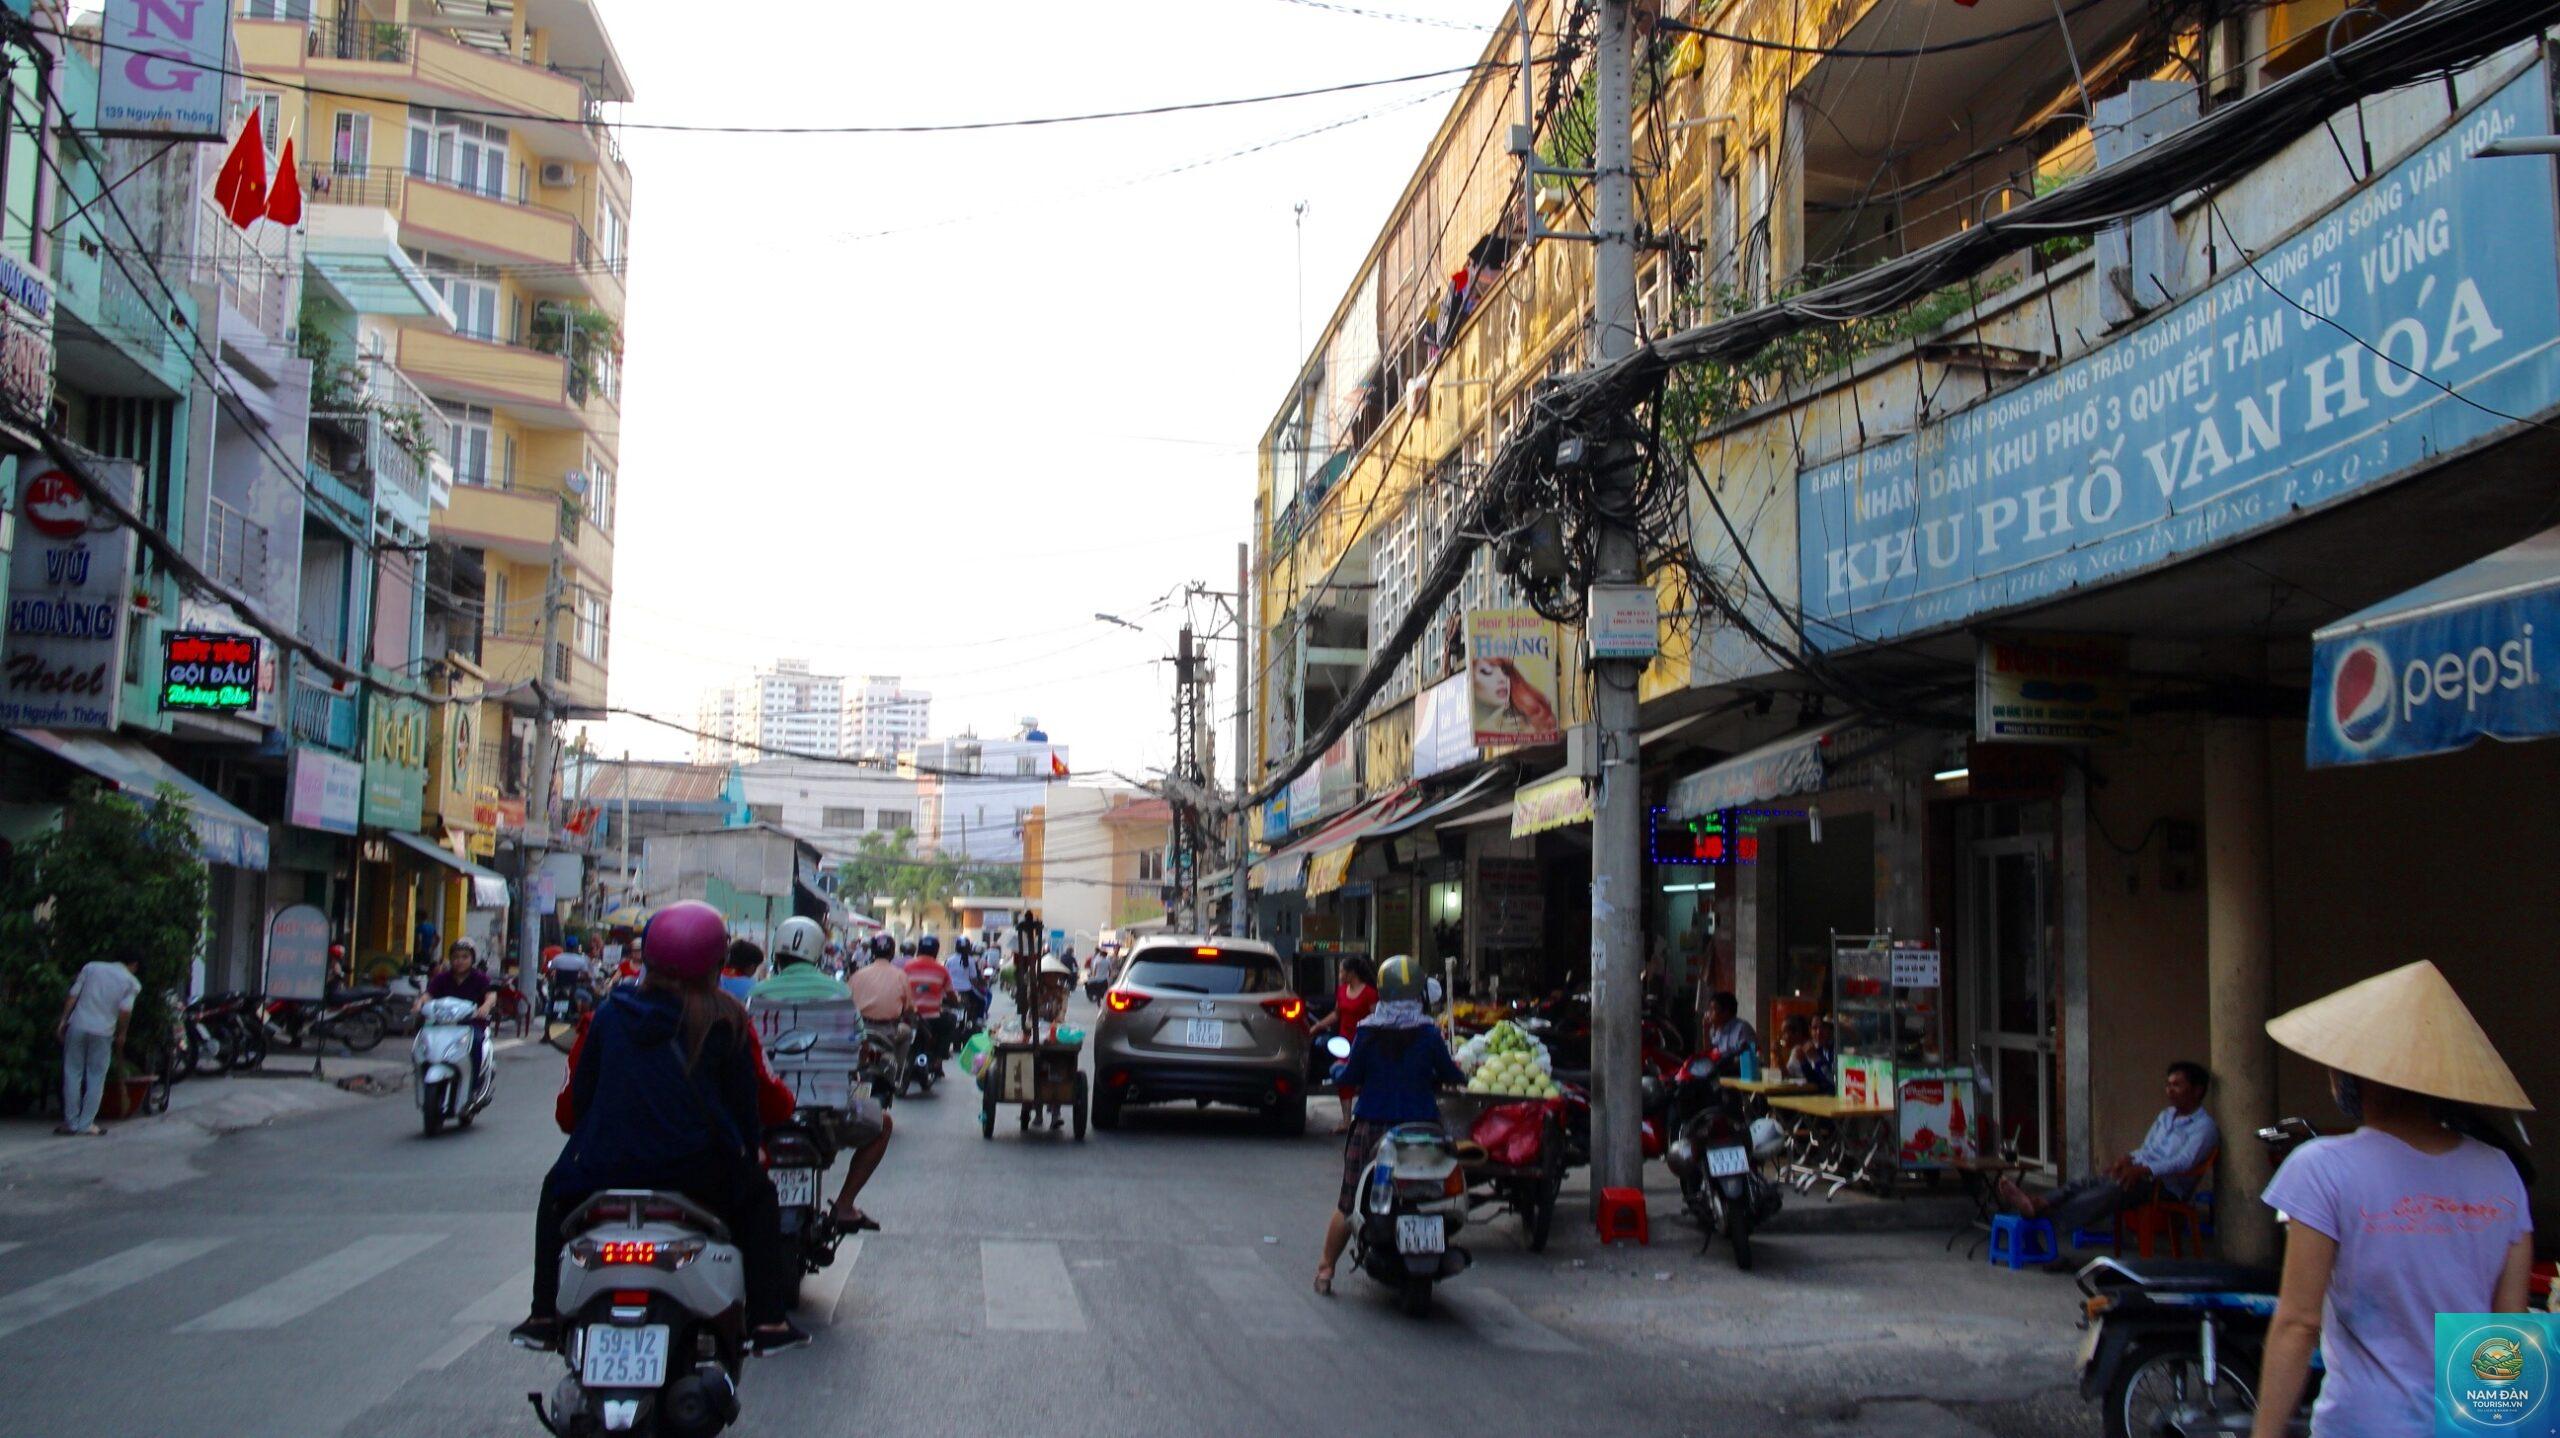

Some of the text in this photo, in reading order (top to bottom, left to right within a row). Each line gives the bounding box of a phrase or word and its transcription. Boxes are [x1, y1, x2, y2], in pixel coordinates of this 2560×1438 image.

[105, 107, 124, 119] 139
[1811, 468, 1840, 494] BAN
[1873, 448, 1900, 476] ĐẠO
[1951, 415, 1983, 445] VẬN
[2034, 369, 2088, 411] PHONG
[2312, 218, 2343, 259] ĐỜI
[2348, 181, 2403, 237] SỐNG
[2408, 144, 2451, 196] VĂN
[1855, 207, 2449, 525] NHÂN DÂN KHU PHỐ 3 QUYẾT TÂM GIỮ VỮNG
[1824, 273, 2504, 599] KHU PHỐ VĂN HÓA
[2056, 560, 2078, 582] 86
[1477, 615, 1545, 630] Hair Salon
[3, 651, 108, 698] Hotel
[169, 662, 205, 685] GỘI
[210, 661, 251, 685] ĐẦU
[2403, 622, 2536, 723] pepsi
[600, 1330, 657, 1355] 59-V2
[590, 1357, 659, 1383] 125.31
